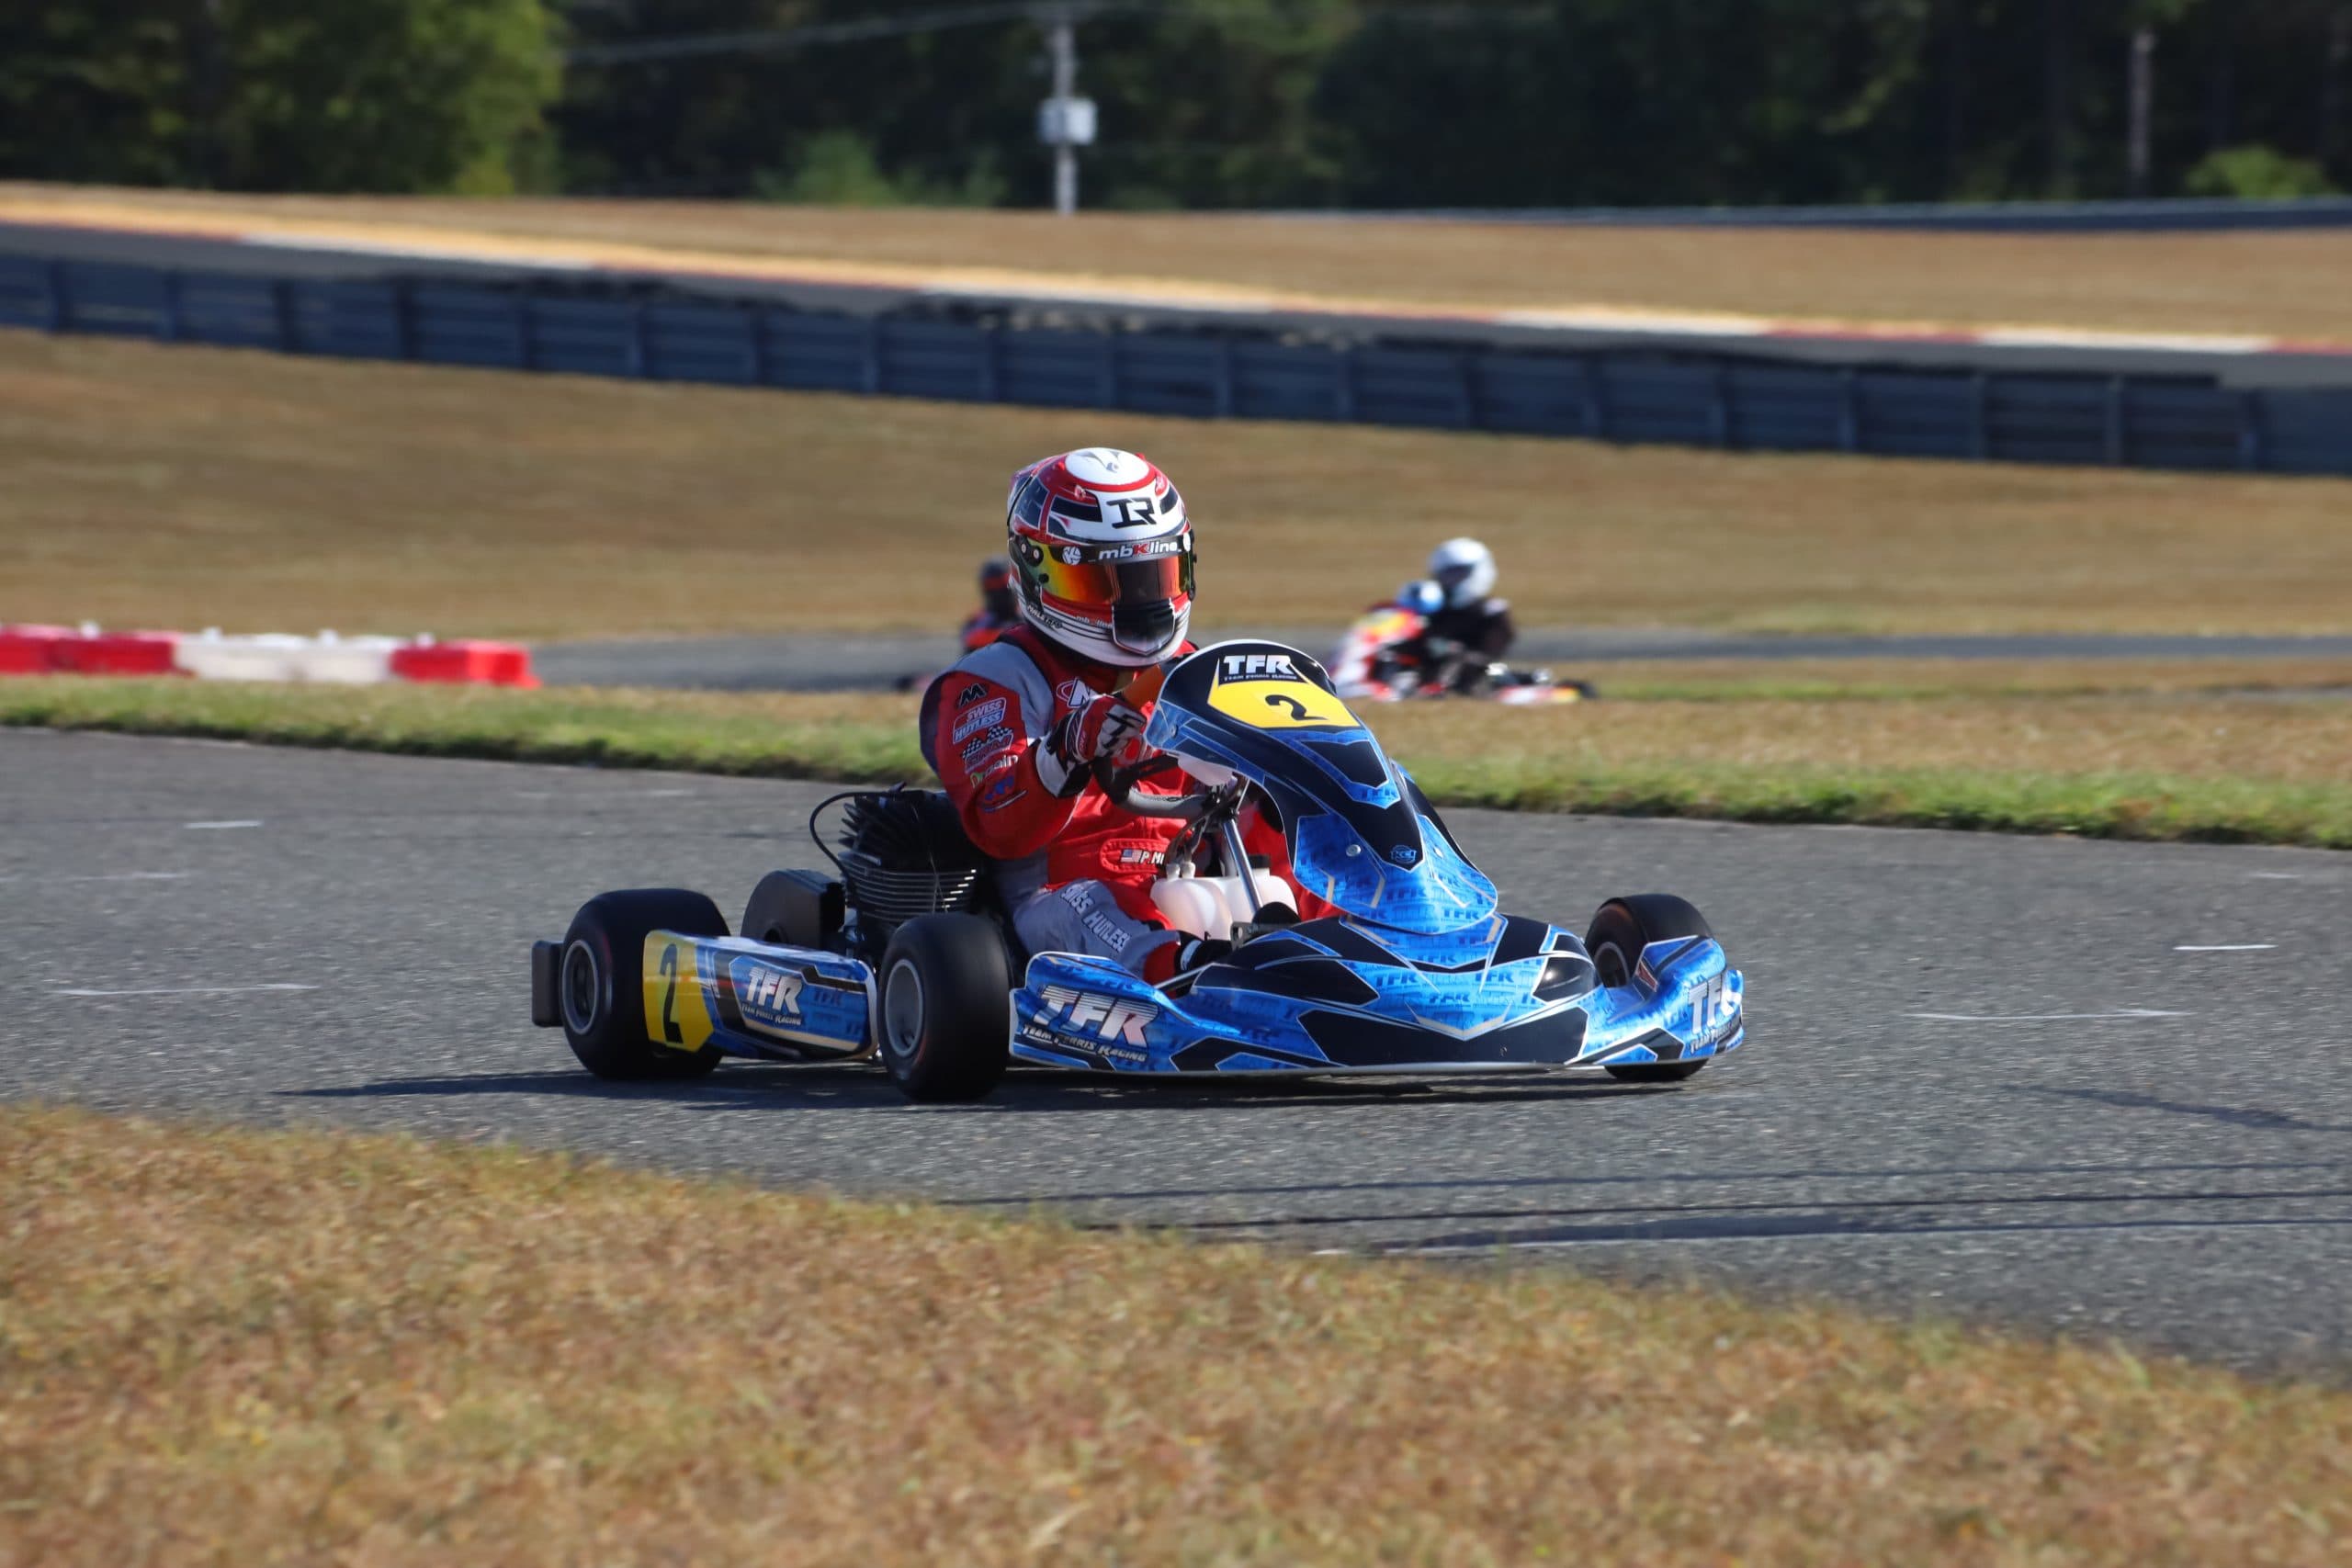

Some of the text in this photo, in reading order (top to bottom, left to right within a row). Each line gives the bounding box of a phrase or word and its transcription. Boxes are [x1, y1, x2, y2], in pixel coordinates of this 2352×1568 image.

[1224, 655, 1294, 674] TFR
[1265, 694, 1329, 721] 2
[660, 943, 684, 1043] 2
[746, 965, 803, 1015] TFR
[1033, 985, 1159, 1048] TFR
[1098, 1044, 1148, 1063] RACING
